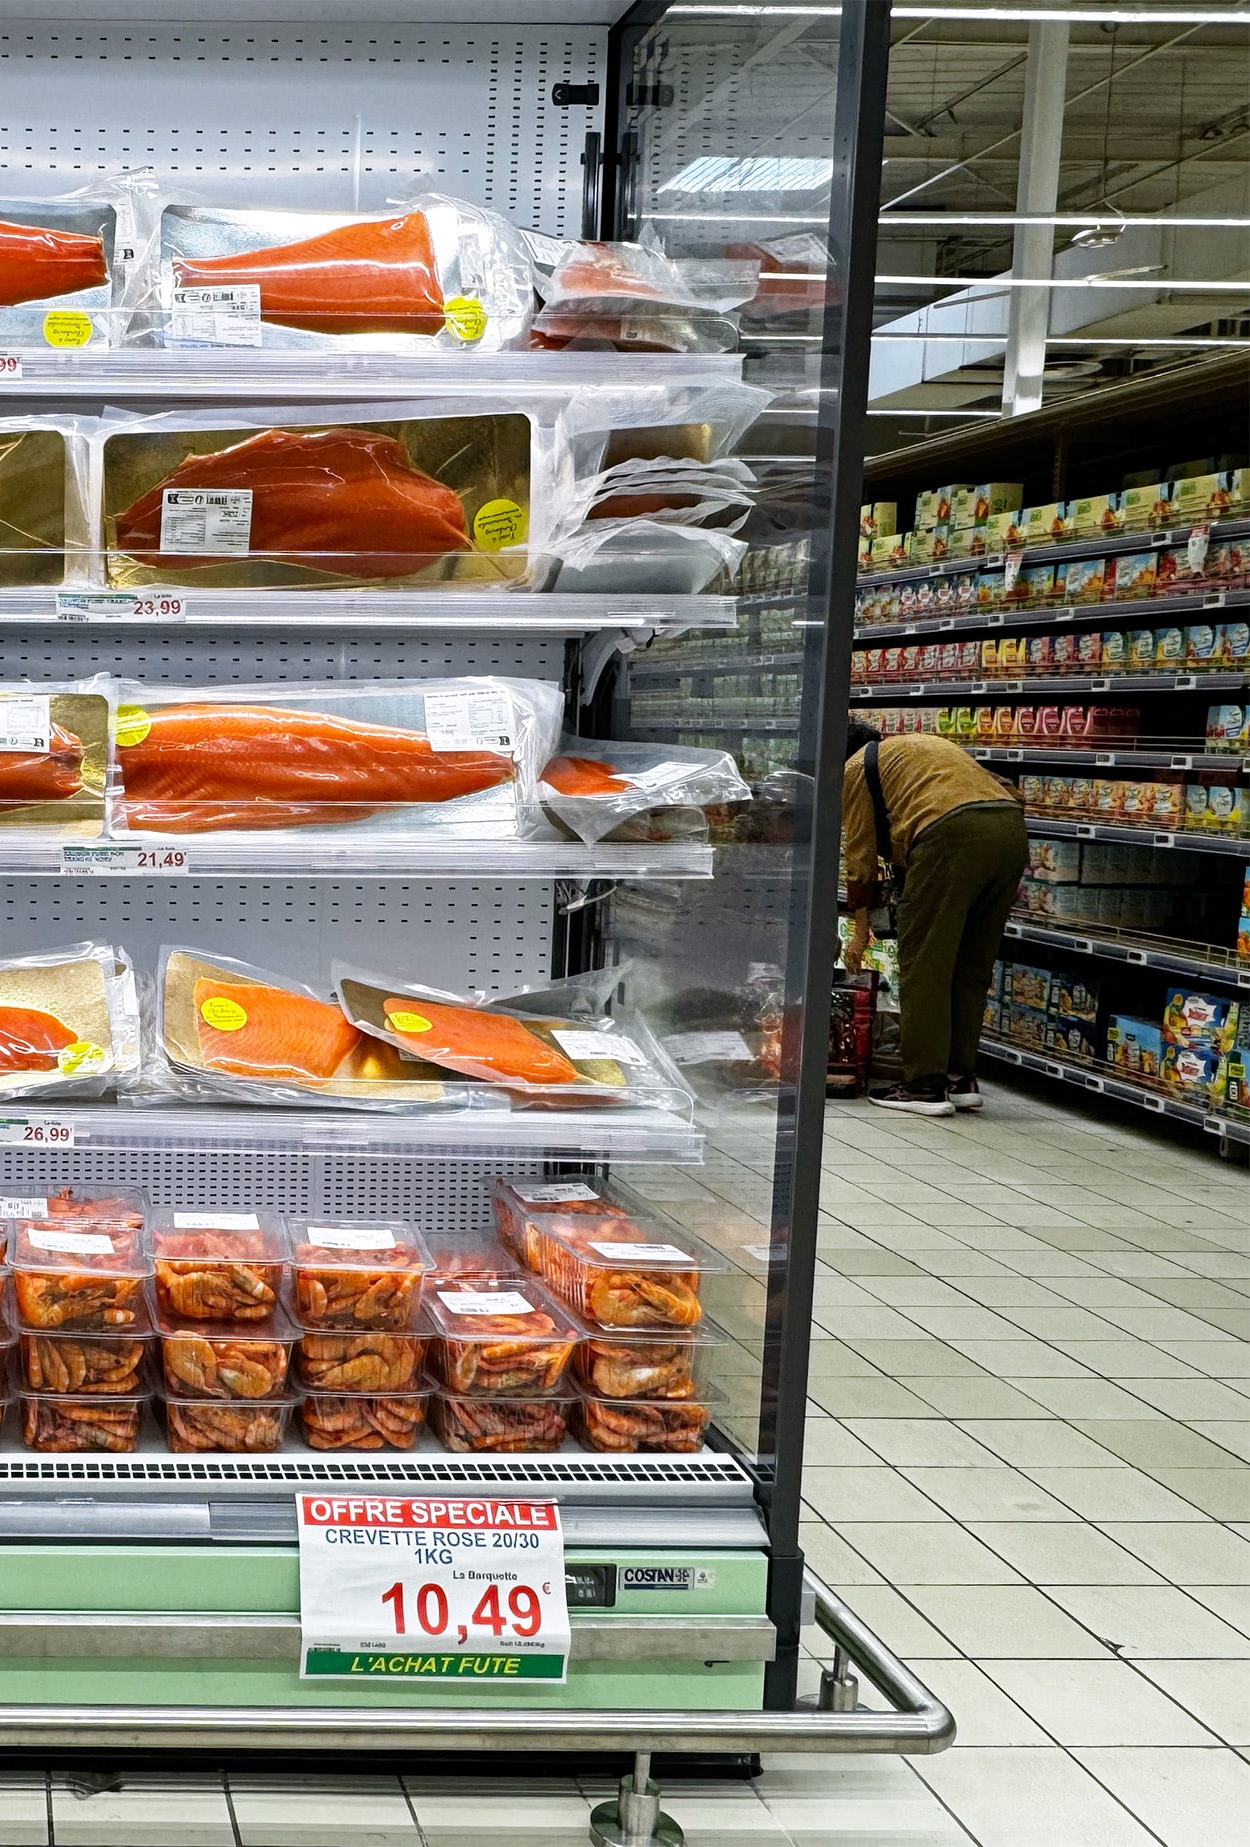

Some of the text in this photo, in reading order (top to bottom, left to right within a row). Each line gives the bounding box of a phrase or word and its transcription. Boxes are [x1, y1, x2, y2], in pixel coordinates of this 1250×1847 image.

[133, 599, 182, 617] 23,99
[137, 851, 185, 869] 21,49
[23, 1126, 70, 1143] 26,99
[309, 1499, 550, 1527] OFFRE SPECIALE
[325, 1528, 540, 1549] CREVETTE ROSE 20/30
[414, 1548, 454, 1565] 1KG
[452, 1569, 466, 1581] La
[624, 1568, 675, 1583] COSTAN
[381, 1581, 542, 1646] 10,49
[350, 1656, 522, 1675] L'ACHAT FUTE
